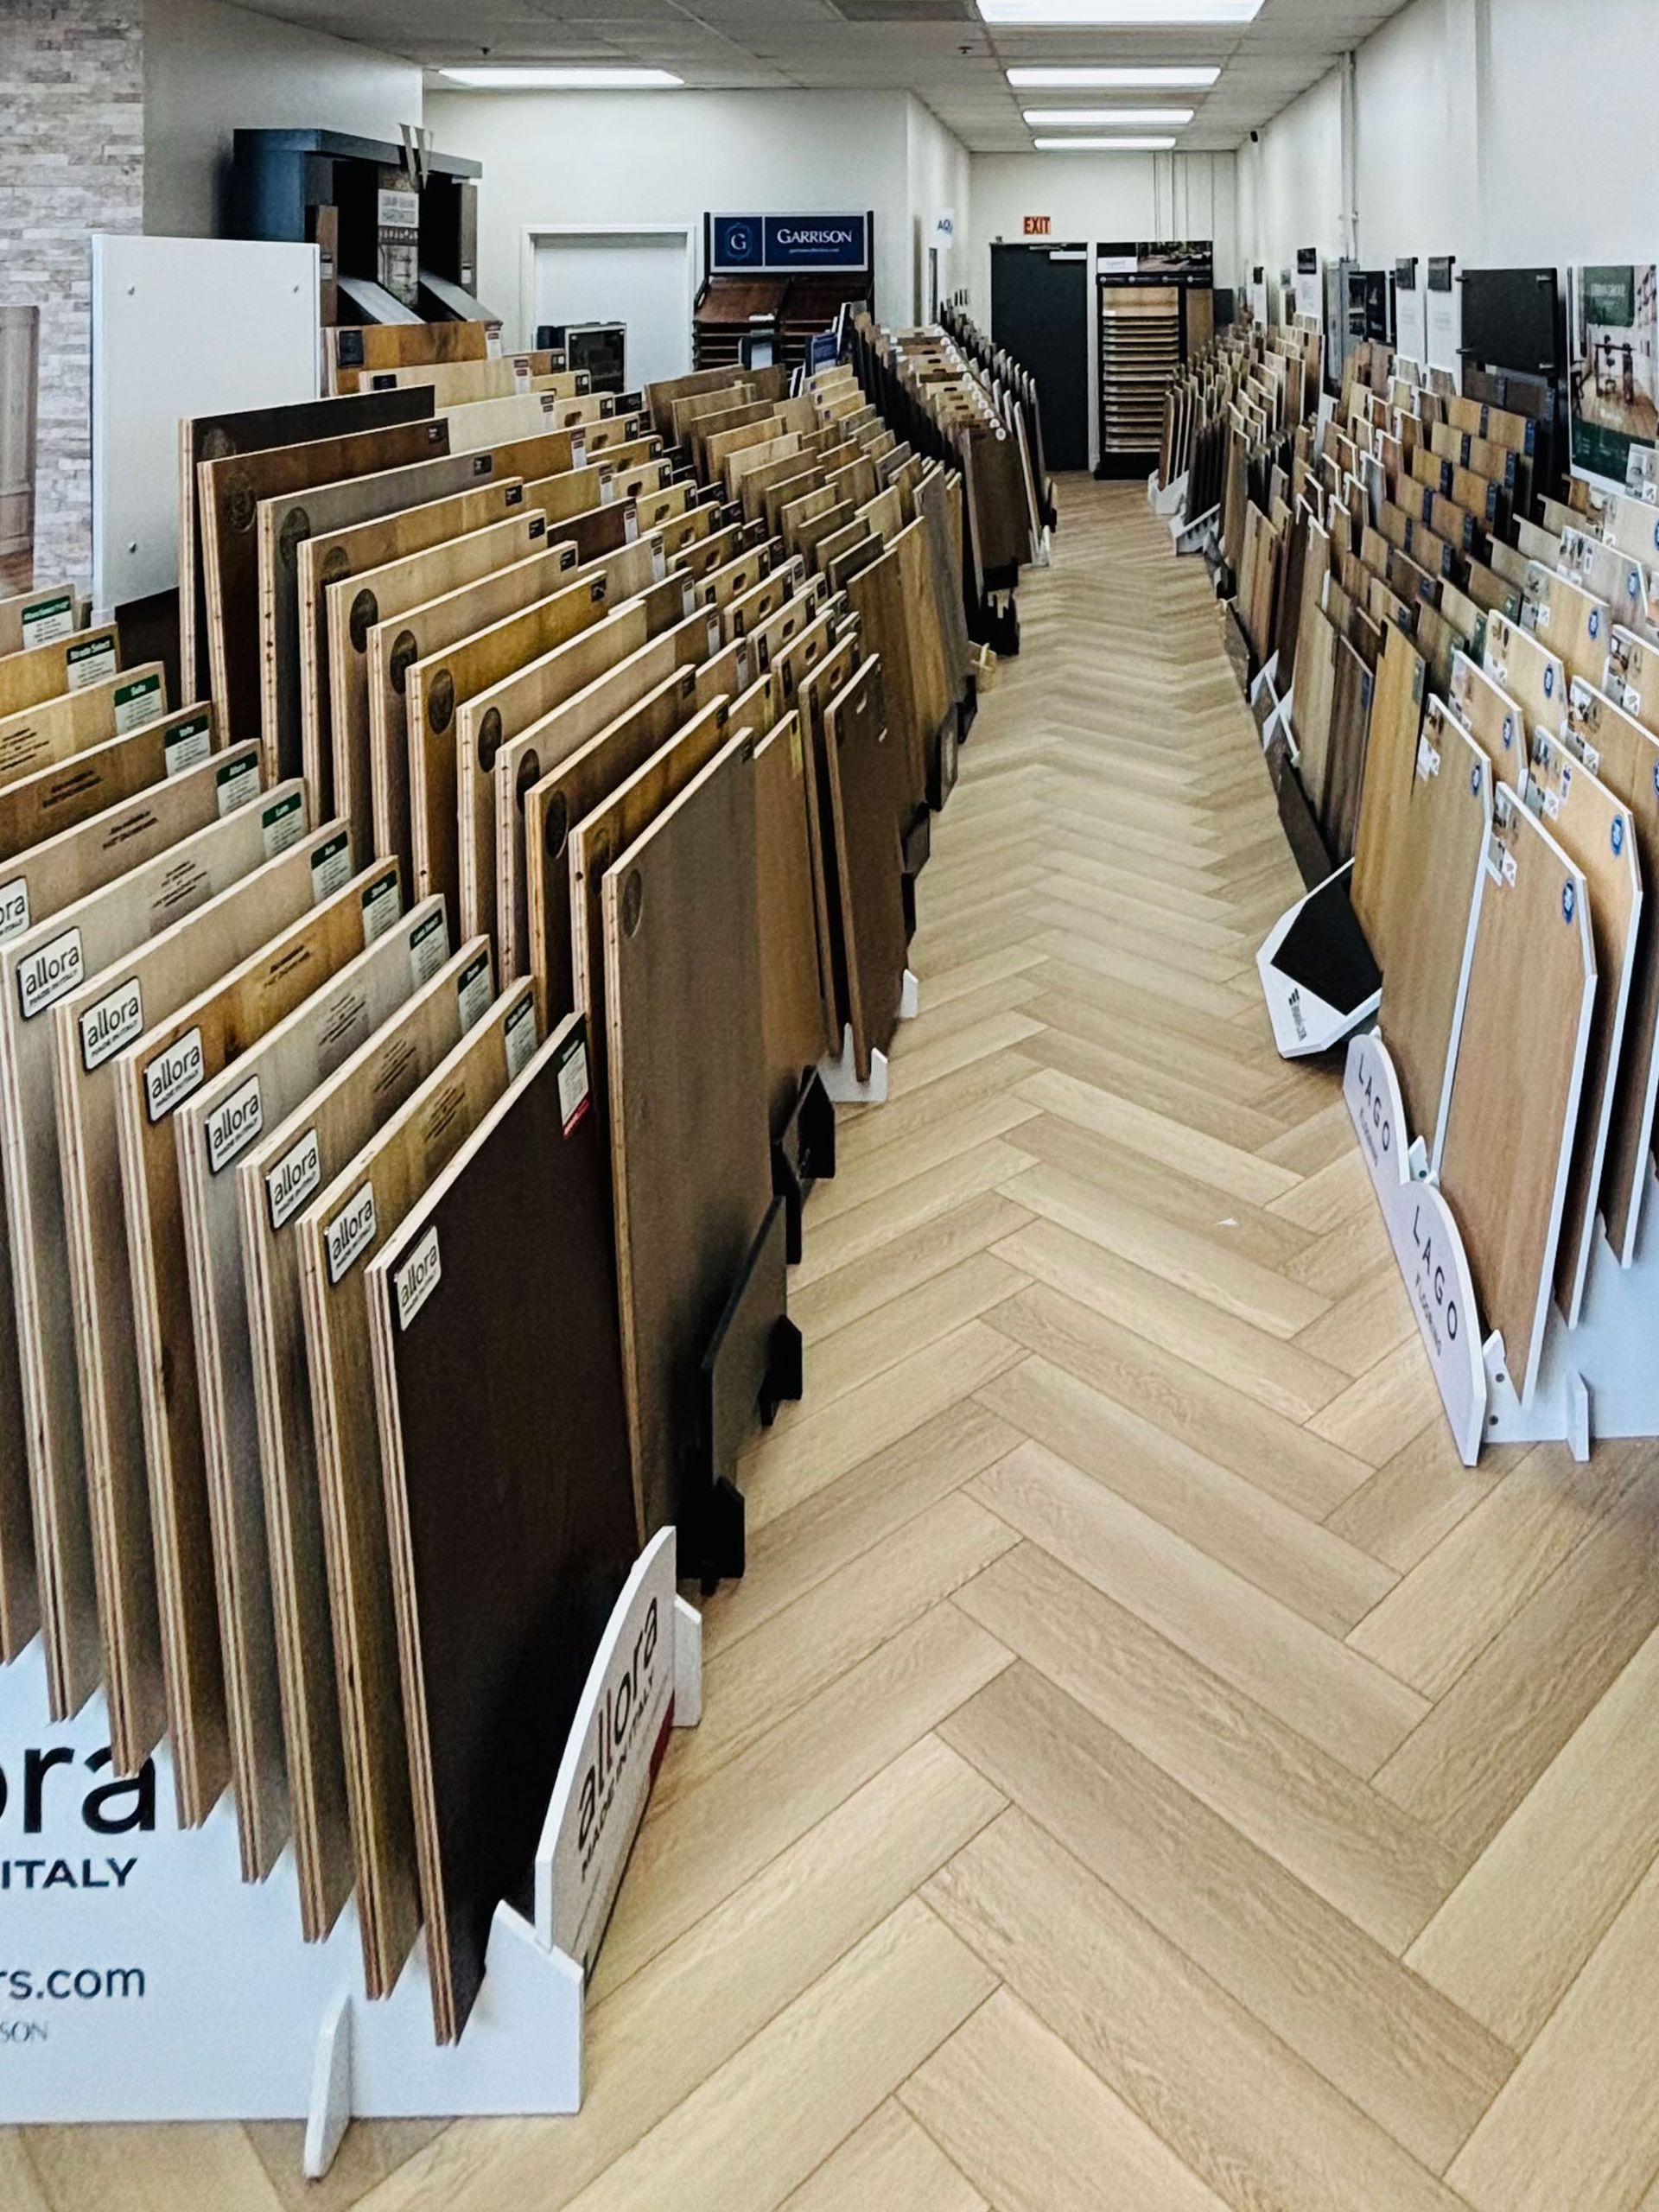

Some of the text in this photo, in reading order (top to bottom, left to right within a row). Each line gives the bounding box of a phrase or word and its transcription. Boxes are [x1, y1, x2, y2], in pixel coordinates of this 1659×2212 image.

[730, 233, 747, 250] G
[778, 229, 852, 244] GARRISON
[1025, 217, 1050, 234] EXIT
[25, 946, 79, 995] allora
[87, 996, 139, 1047] allora
[152, 1046, 200, 1099] allora
[213, 1095, 259, 1149] allora
[1358, 1052, 1390, 1151] LAGO
[274, 1147, 317, 1205] allora
[333, 1199, 372, 1261] allora
[401, 1245, 438, 1308] allora
[1413, 1205, 1458, 1340] LAGO
[578, 1597, 658, 1852] allora
[0, 1746, 156, 1834] ra
[2, 1858, 138, 1890] ITALY
